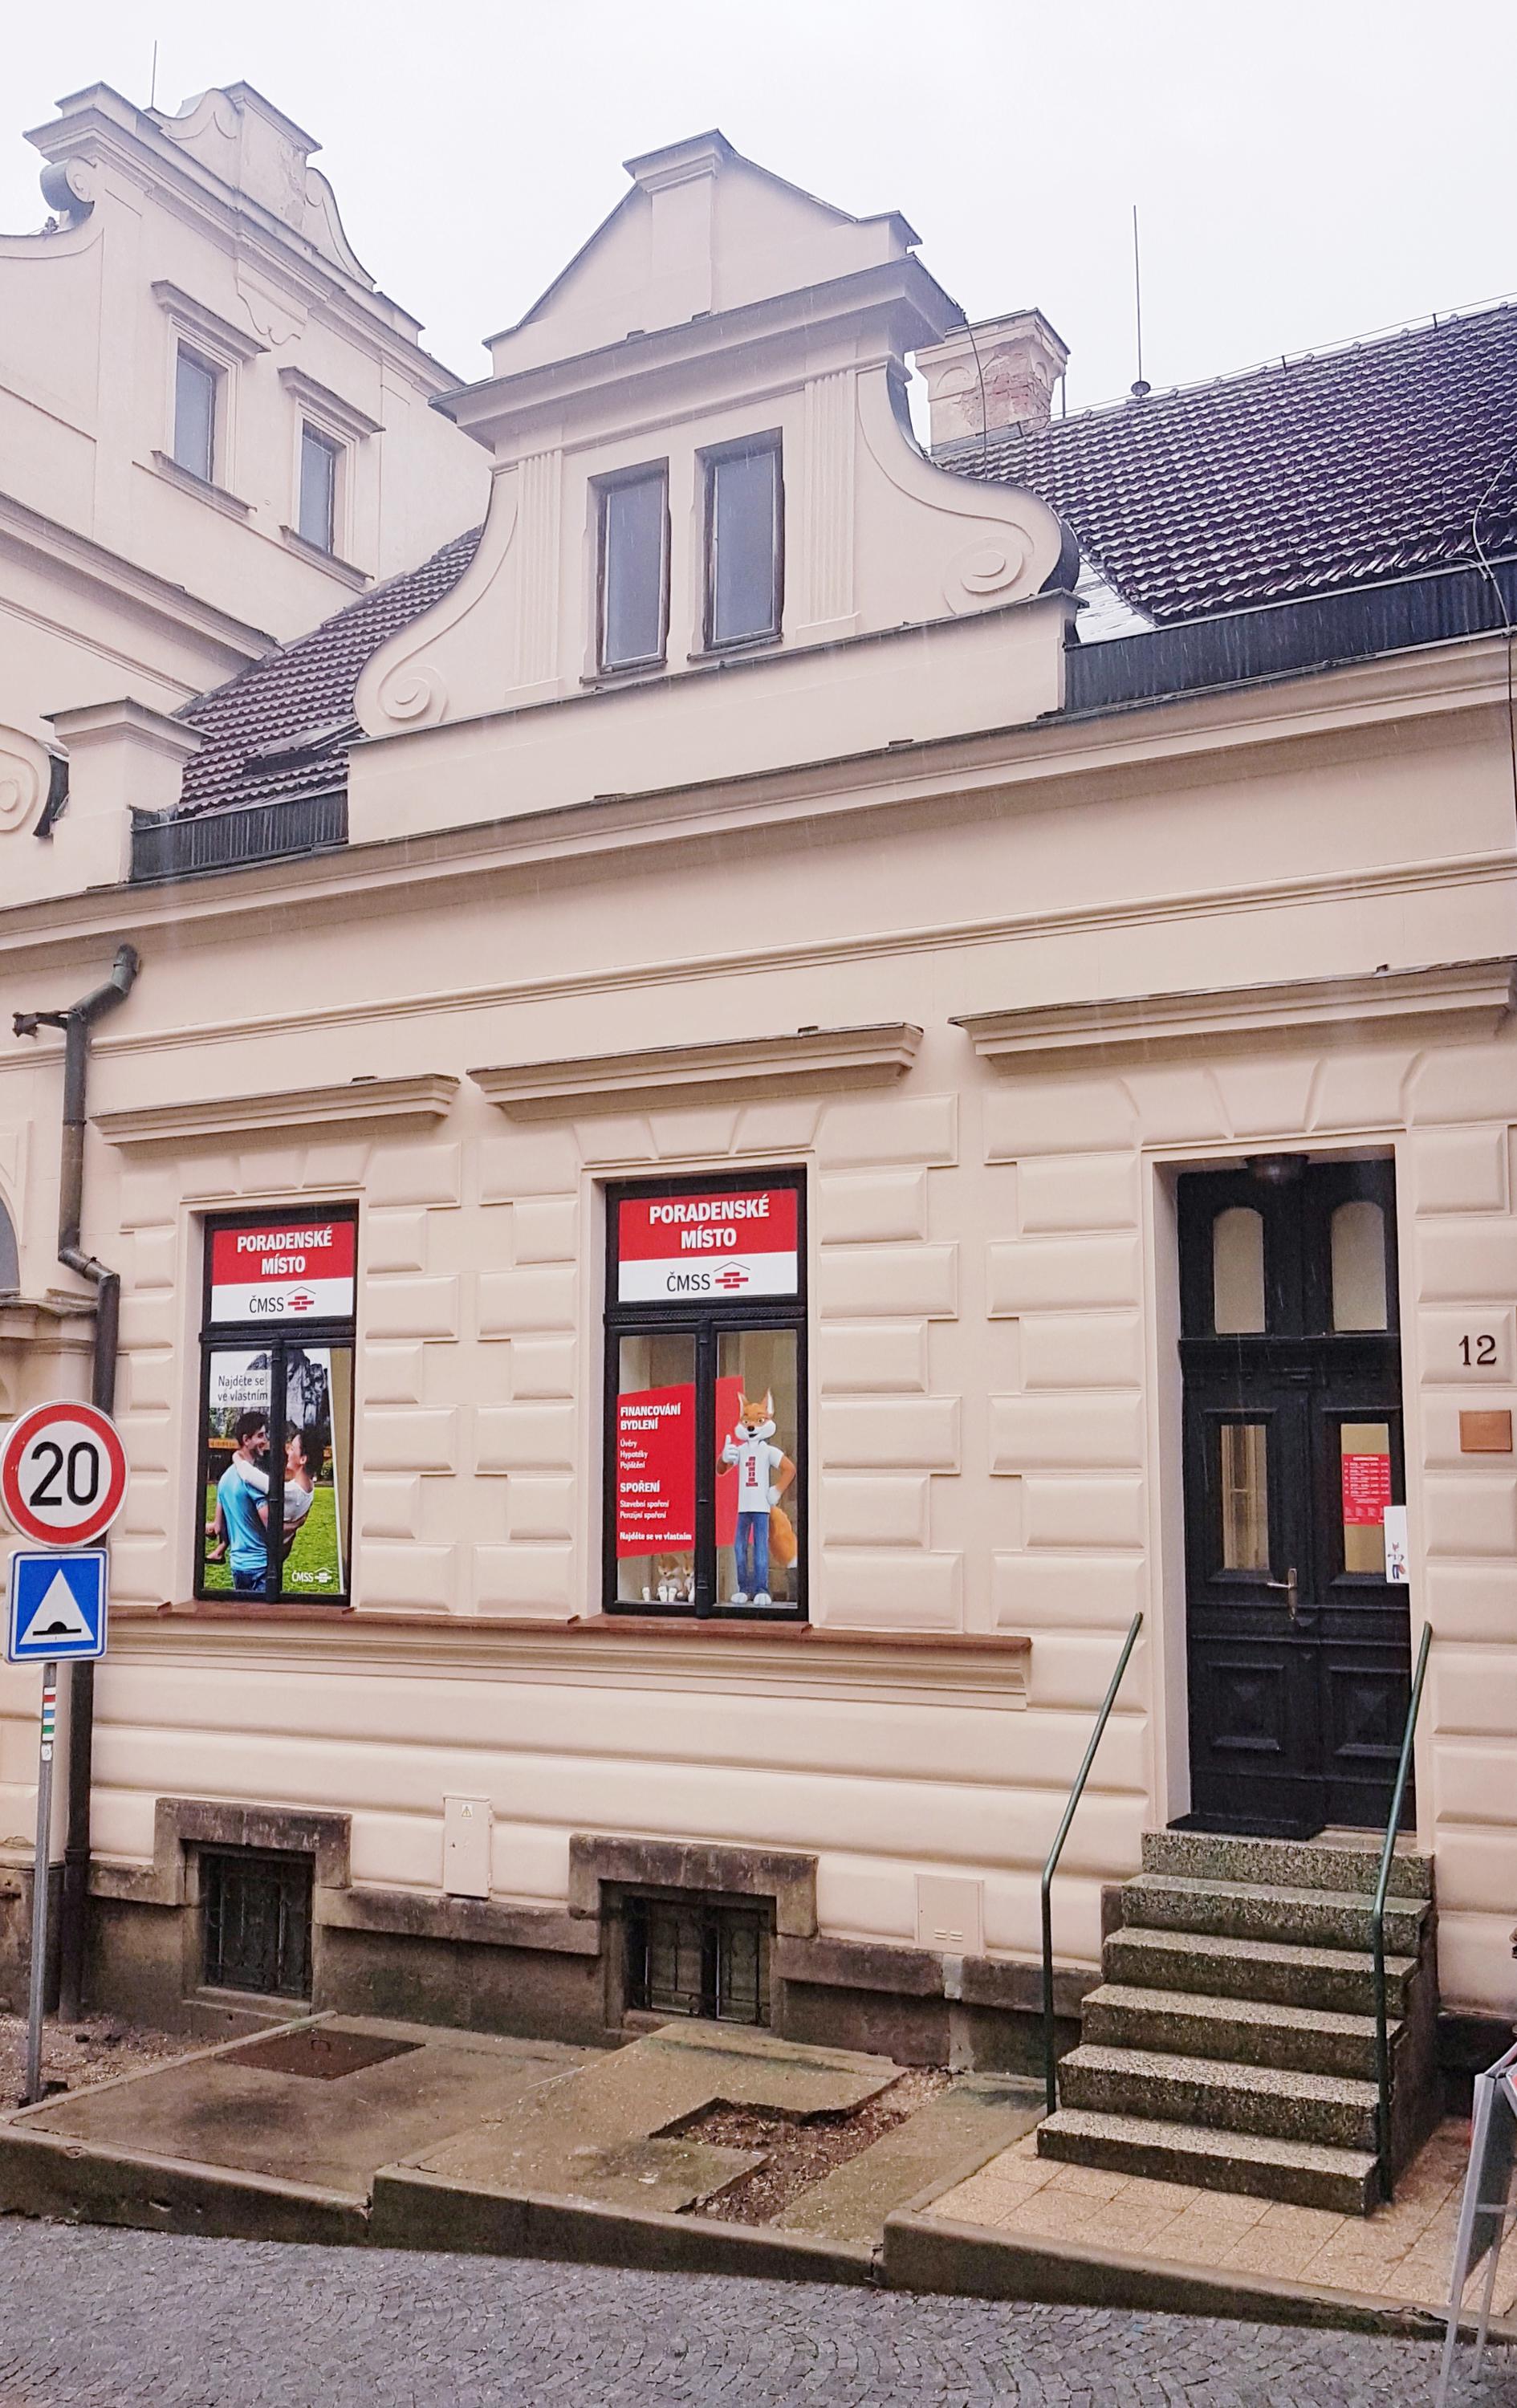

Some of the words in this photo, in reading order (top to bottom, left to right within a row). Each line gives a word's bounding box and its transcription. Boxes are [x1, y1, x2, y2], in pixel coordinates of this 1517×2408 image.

[649, 1194, 771, 1225] PORADENSKÉ
[237, 1226, 333, 1253] PORADENSKÉ
[681, 1225, 737, 1250] MÍSTO
[261, 1253, 307, 1275] MÍSTO
[666, 1271, 710, 1292] ČMSS
[249, 1295, 285, 1314] ČMSS
[1458, 1334, 1498, 1366] 12
[218, 1374, 253, 1390] Najděte
[254, 1377, 265, 1386] se
[218, 1393, 228, 1401] ve
[230, 1389, 269, 1402] vlastním
[620, 1402, 681, 1418] FINANCOVÁNÍ
[620, 1417, 659, 1431] BYDLENÍ
[29, 1441, 100, 1507] 20
[620, 1479, 661, 1493] SPOŘENÍ
